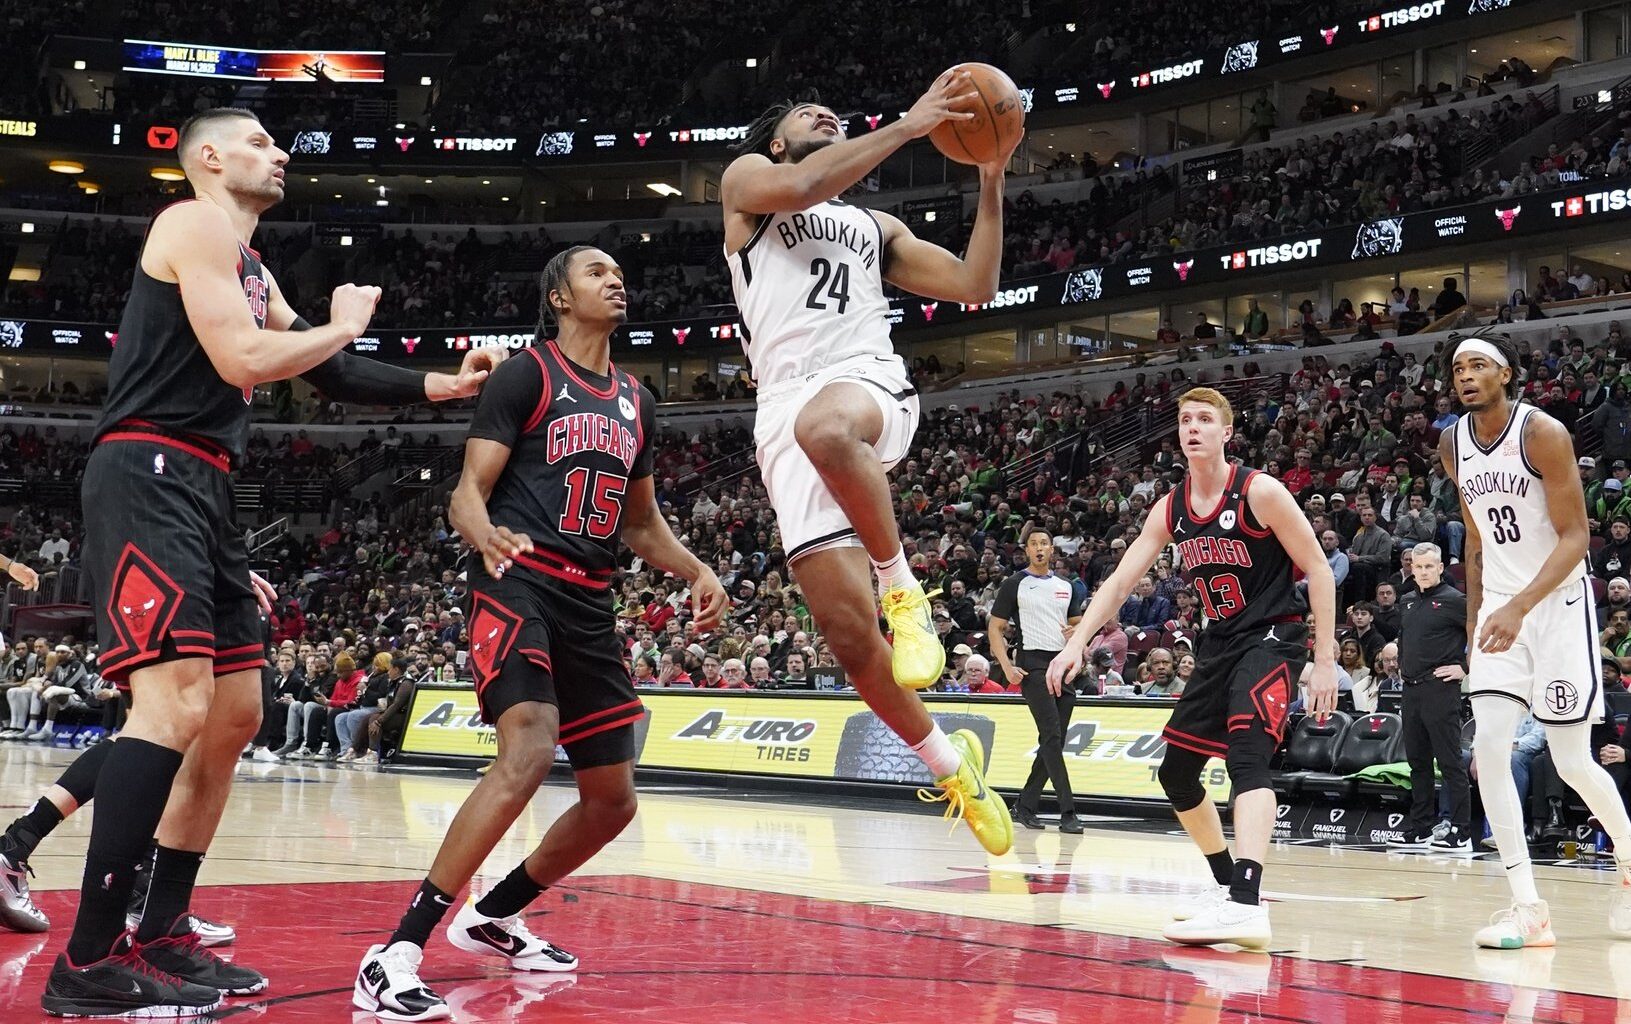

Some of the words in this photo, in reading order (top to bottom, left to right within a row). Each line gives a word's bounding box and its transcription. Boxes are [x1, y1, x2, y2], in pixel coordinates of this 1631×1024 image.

[1381, 0, 1446, 28] TISSOT
[1279, 35, 1302, 46] OFFICIAL
[1281, 43, 1300, 53] WATCH
[1150, 59, 1204, 85] TISSOT
[1055, 87, 1079, 96] OFFICIAL
[1057, 94, 1077, 102] WATCH
[691, 126, 749, 142] TISSOT
[456, 138, 517, 151] TISSOT
[1435, 215, 1467, 228] OFFICIAL
[777, 203, 875, 271] BROOKLYN
[1438, 225, 1464, 237] WATCH
[1247, 238, 1322, 267] TISSOT
[1127, 267, 1152, 278] OFFICIAL
[806, 257, 850, 315] 24
[1129, 276, 1150, 286] WATCH
[52, 329, 82, 338] OFFICIAL
[353, 337, 381, 345] OFFICIAL
[469, 334, 535, 350] TISSOT
[1460, 471, 1530, 505] BROOKLYN
[558, 467, 628, 540] 15
[1488, 505, 1521, 545] 33
[1178, 536, 1253, 571] HICAGO
[1194, 572, 1247, 621] 13
[476, 732, 497, 745] TIR
[756, 745, 810, 762] TIRES
[1312, 824, 1347, 833] FANDUEL
